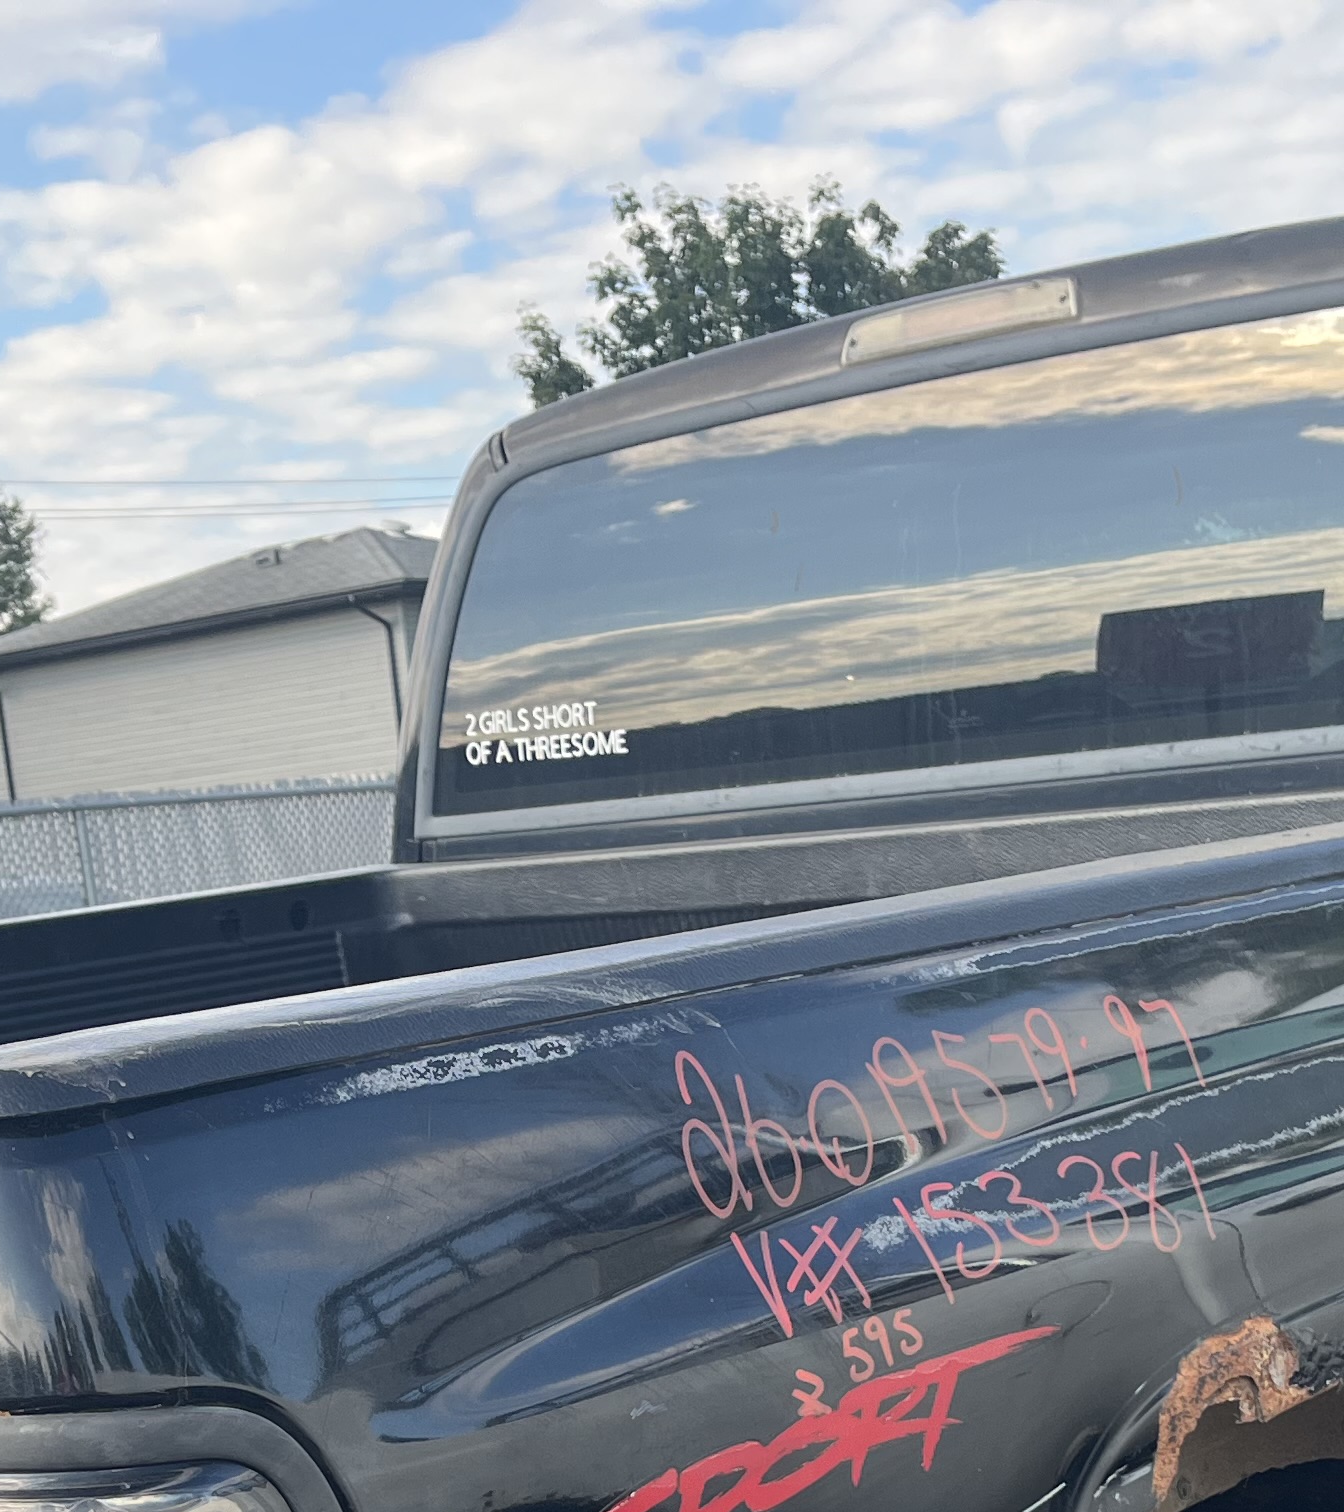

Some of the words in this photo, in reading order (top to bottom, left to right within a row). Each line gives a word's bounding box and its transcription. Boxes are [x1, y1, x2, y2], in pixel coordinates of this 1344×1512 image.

[464, 713, 477, 737] 2
[479, 708, 531, 735] GIRLS
[532, 701, 598, 731] SHORT
[465, 741, 492, 766] OF
[495, 740, 513, 764] A
[514, 729, 629, 762] THREESOME
